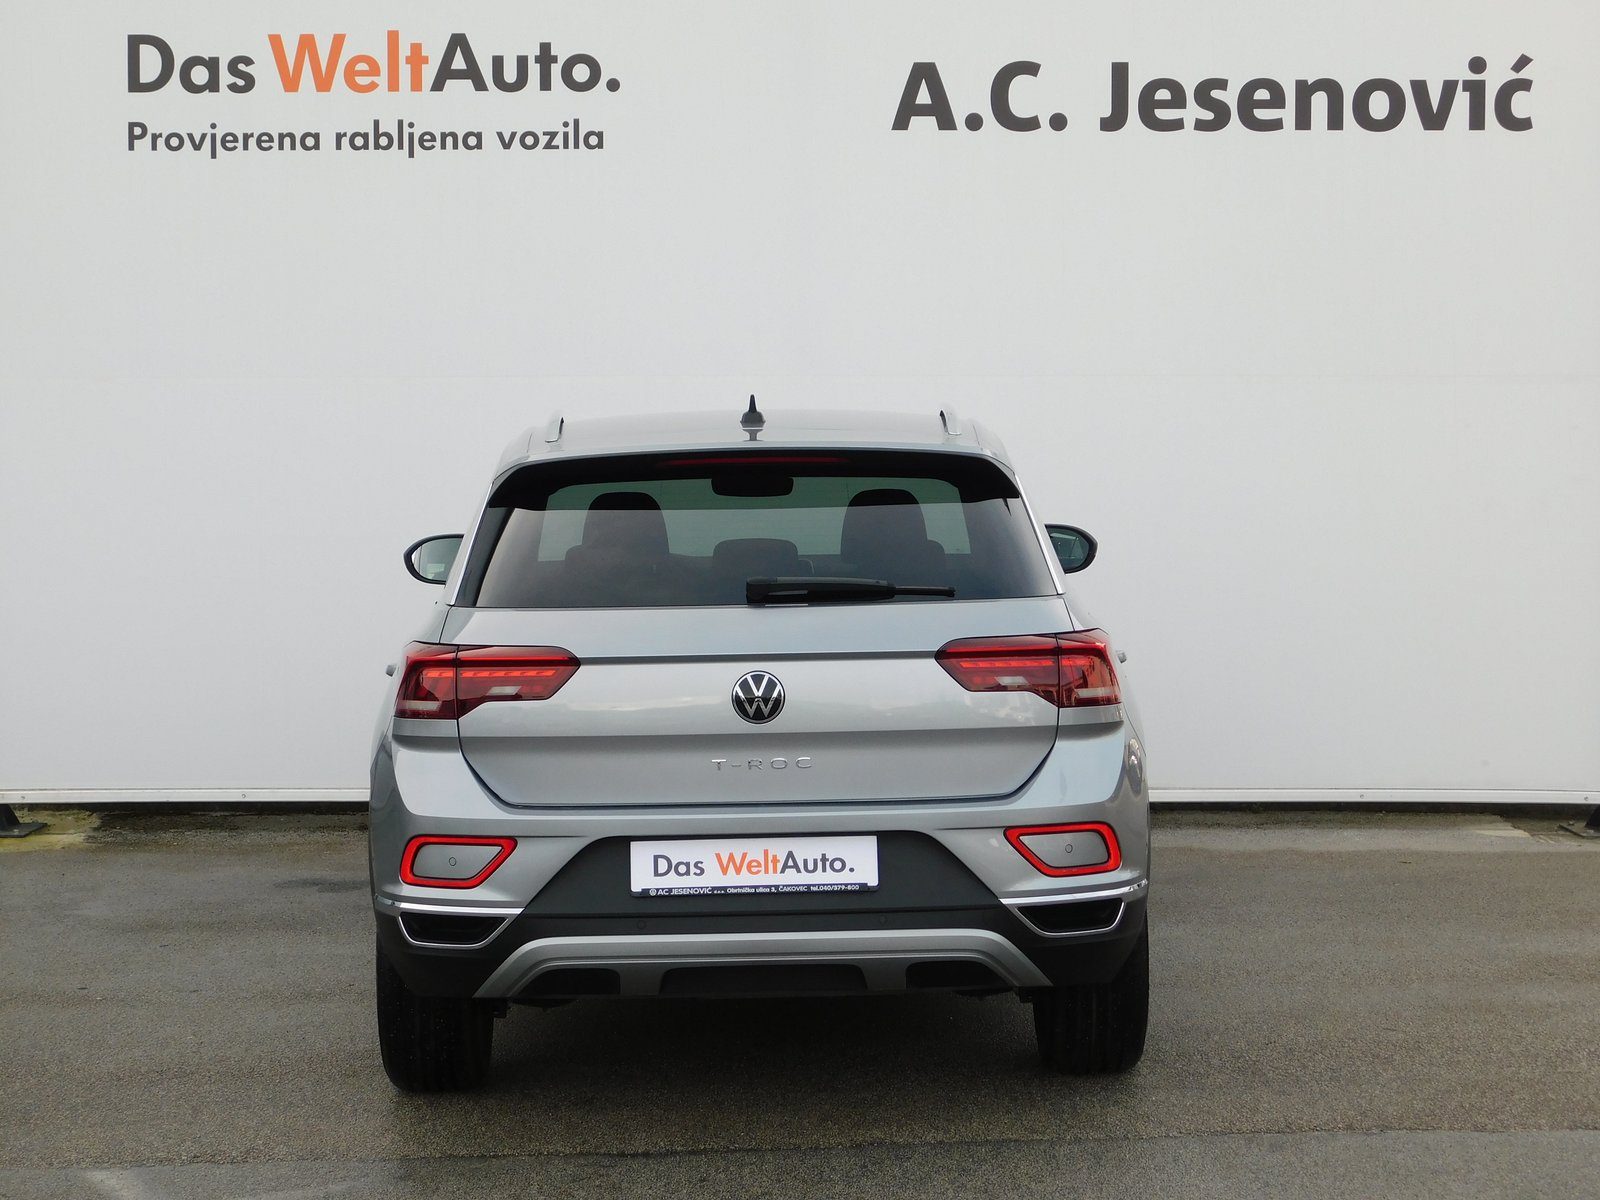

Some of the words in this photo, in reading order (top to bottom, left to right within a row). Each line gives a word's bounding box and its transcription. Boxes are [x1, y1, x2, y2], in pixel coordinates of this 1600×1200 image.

[127, 34, 256, 94] Das
[267, 29, 621, 93] WeltAuto.
[891, 60, 1068, 133] A.C.
[1099, 53, 1534, 133] Jesenović
[127, 121, 321, 160] Provjerena
[335, 118, 483, 159] rabljena
[496, 118, 604, 151] vozila
[711, 756, 812, 771] T-ROC
[653, 854, 705, 878] Das
[715, 849, 855, 876] WeltAuto.
[657, 888, 669, 896] AC
[670, 886, 713, 895] JESENOVIĆ
